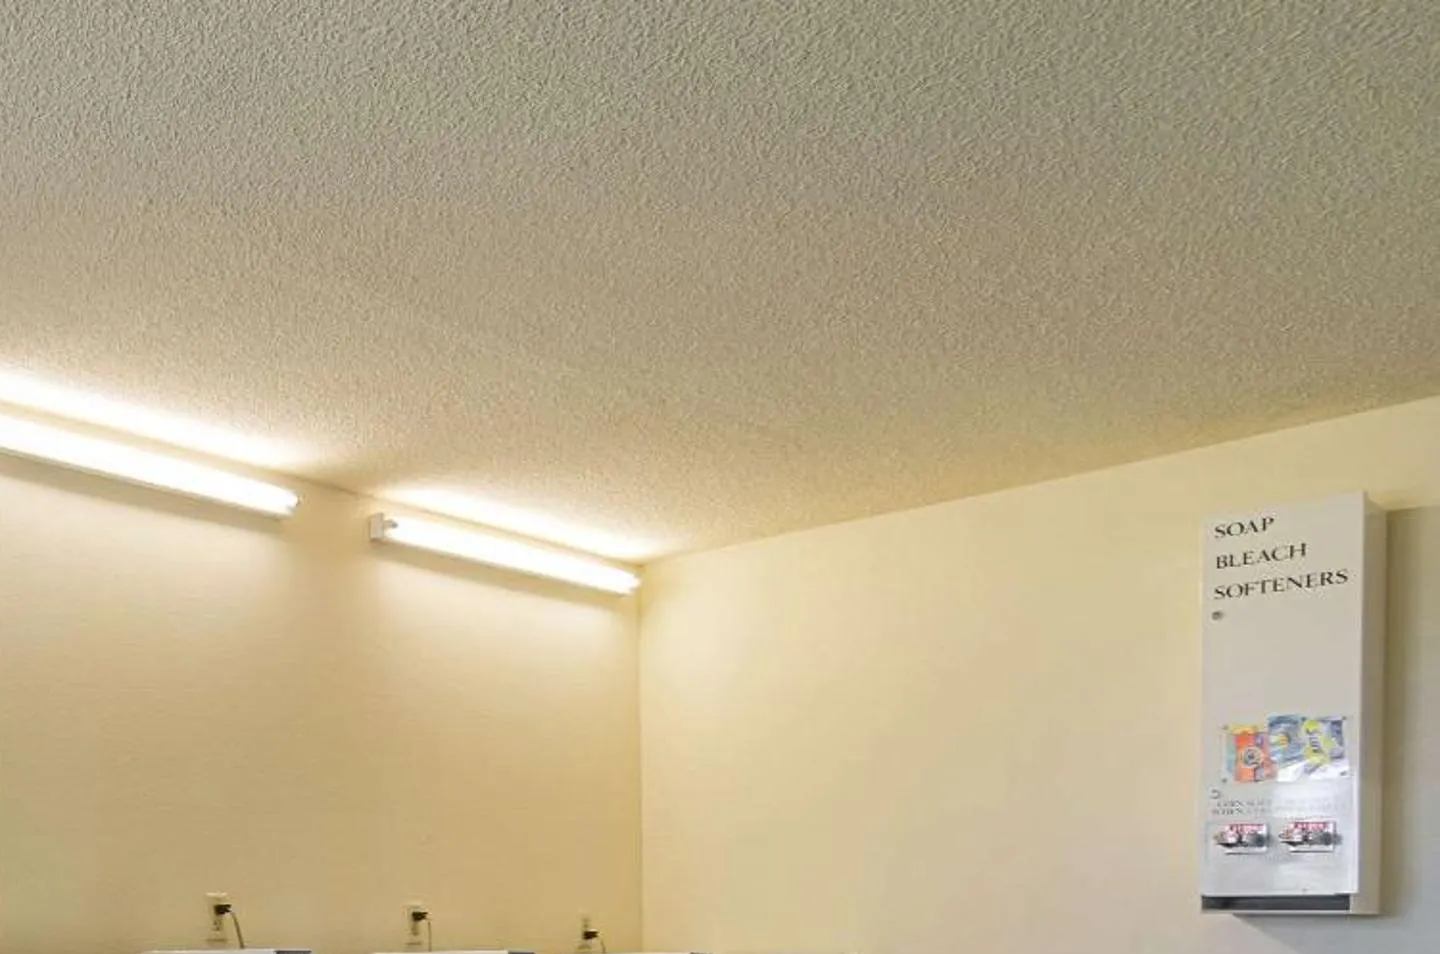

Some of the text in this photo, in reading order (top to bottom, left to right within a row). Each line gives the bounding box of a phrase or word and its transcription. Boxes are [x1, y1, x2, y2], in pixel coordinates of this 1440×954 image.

[1214, 517, 1275, 538] SOAP
[1216, 543, 1307, 569] BLEACH
[1213, 568, 1349, 600] SOFTENERS
